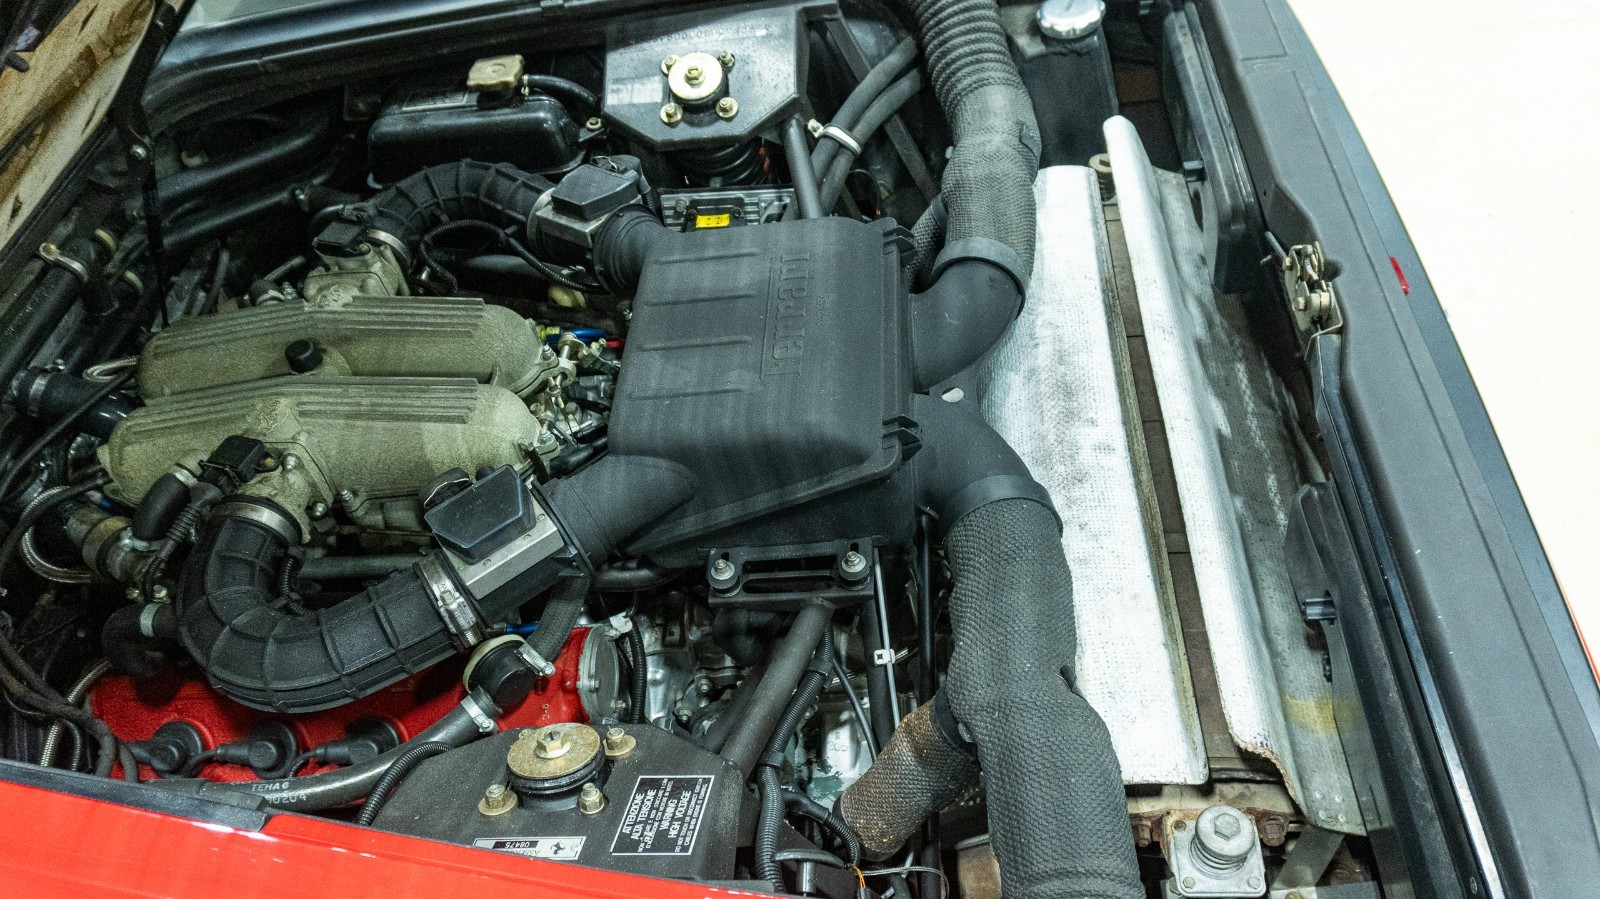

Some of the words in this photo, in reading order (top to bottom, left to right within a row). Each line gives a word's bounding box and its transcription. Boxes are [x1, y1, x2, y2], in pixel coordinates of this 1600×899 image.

[759, 252, 809, 378] Ferrari
[622, 793, 644, 833] ATTENZIONE
[637, 789, 656, 821] TENSIONE
[659, 799, 677, 830] WARNING
[674, 790, 691, 818] VOLTAGE
[631, 823, 644, 839] ALTA
[668, 821, 681, 837] HIGH
